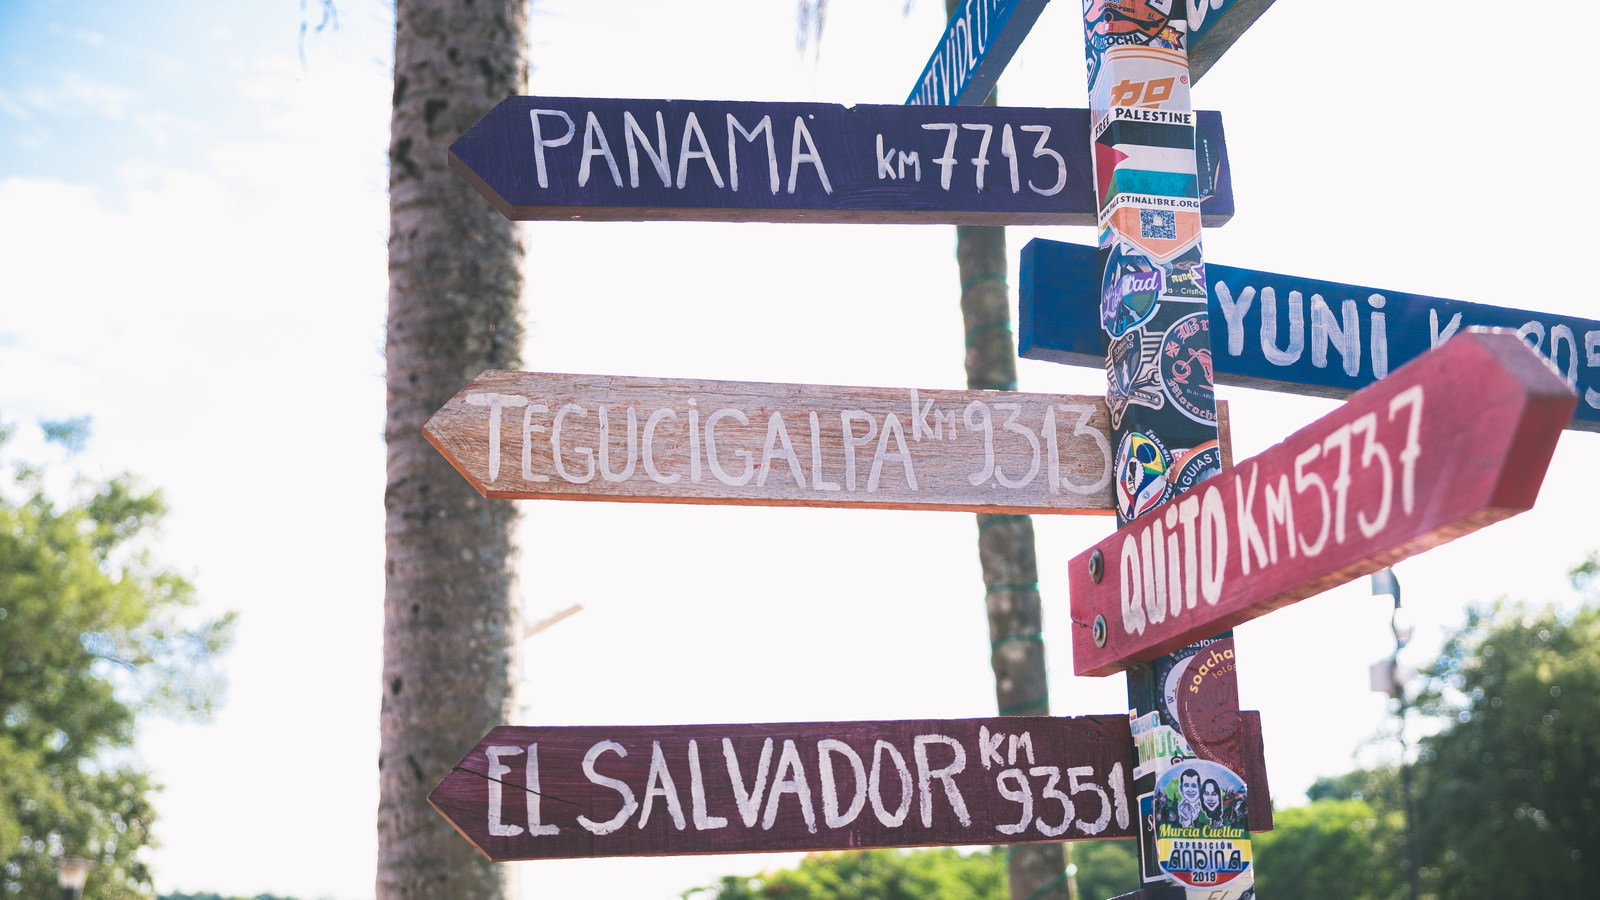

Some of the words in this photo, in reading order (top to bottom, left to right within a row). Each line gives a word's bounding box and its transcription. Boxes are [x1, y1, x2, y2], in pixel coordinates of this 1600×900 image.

[1095, 114, 1110, 137] FREE
[1115, 108, 1192, 124] PALESTINE
[921, 123, 1067, 196] 7713
[1294, 384, 1424, 558] 5737
[1189, 648, 1234, 694] soacha
[485, 742, 561, 837] EL
[576, 734, 972, 836] SALVADOR
[995, 762, 1129, 837] 9351
[1159, 824, 1200, 837] Murcia
[1202, 824, 1245, 838] Cuellar
[1173, 840, 1233, 849] EXPEDICIÓN
[1168, 849, 1241, 869] ANDINA
[1192, 871, 1216, 882] 2019
